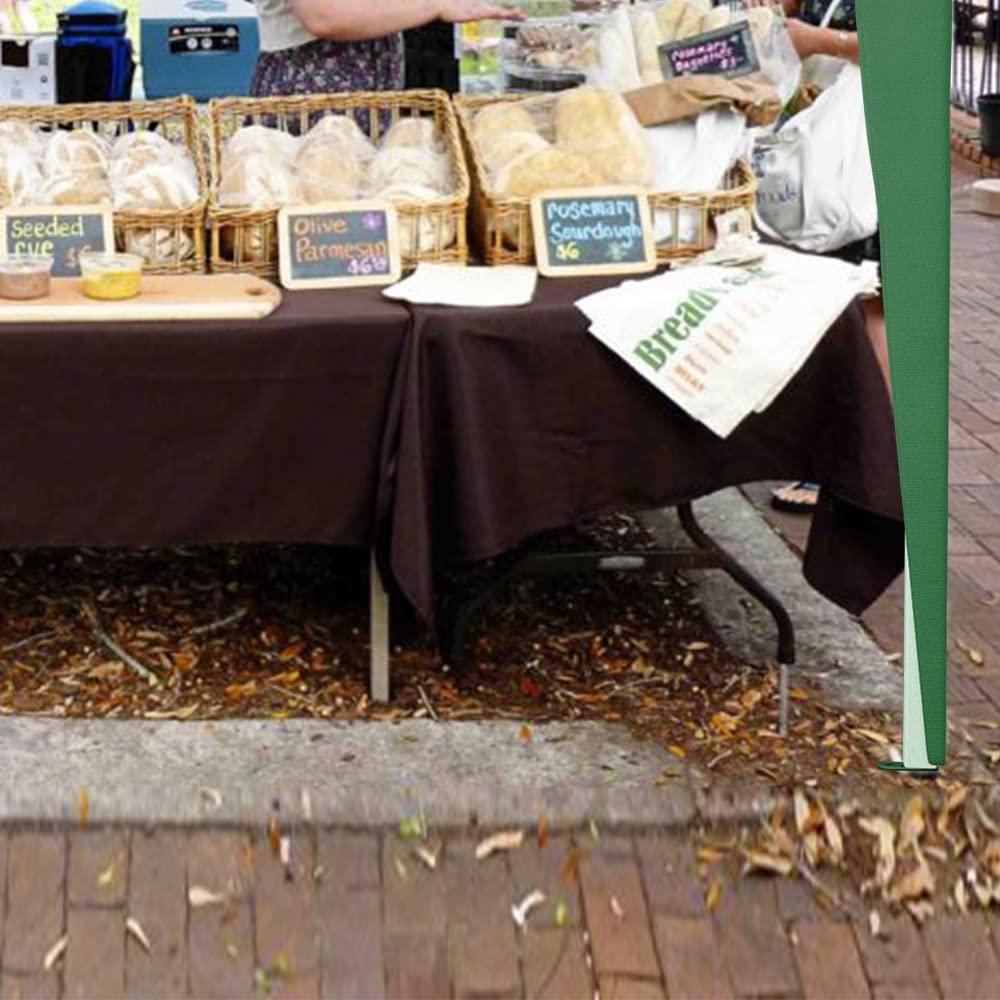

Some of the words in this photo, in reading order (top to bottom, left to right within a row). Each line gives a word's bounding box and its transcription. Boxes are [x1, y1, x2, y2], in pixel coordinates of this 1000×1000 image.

[294, 217, 348, 236] Olive
[295, 236, 387, 263] Parmesan
[631, 286, 720, 373] Bread
